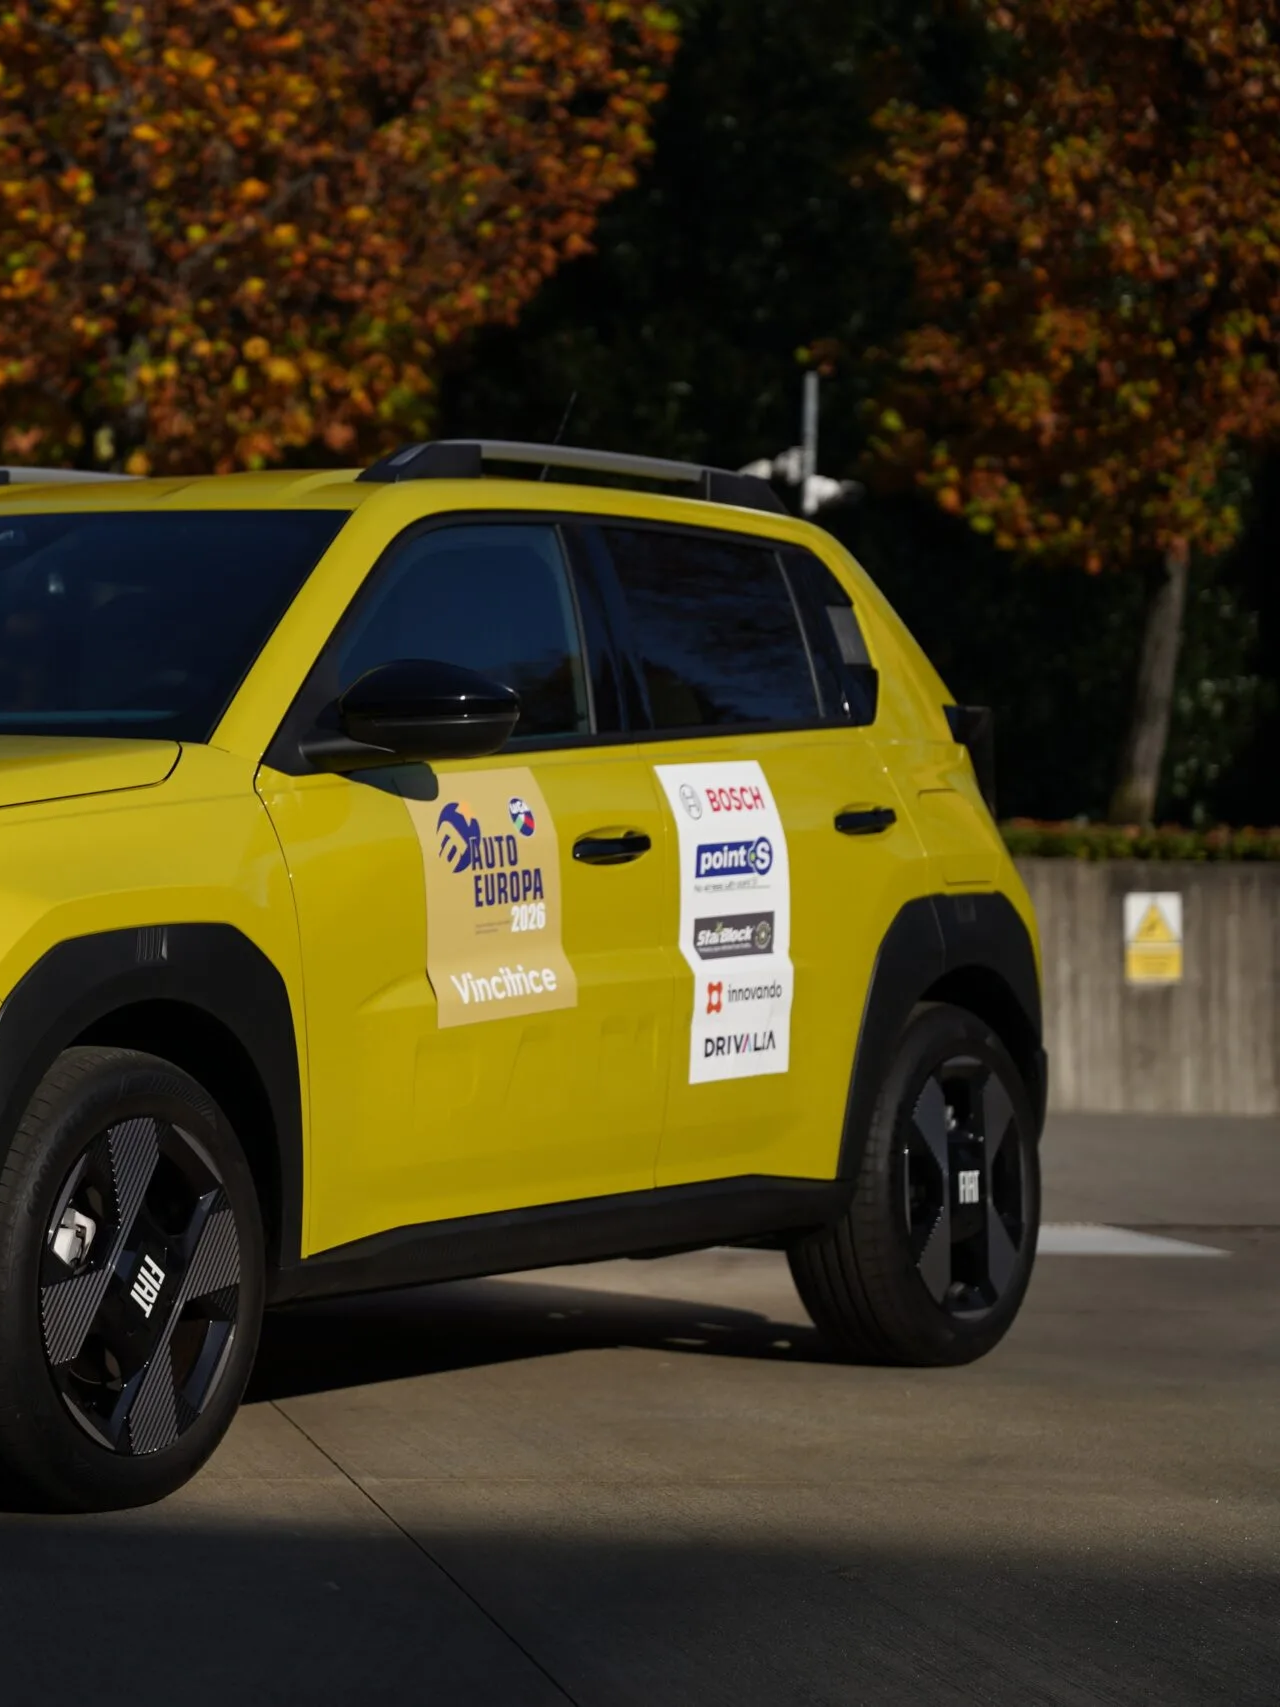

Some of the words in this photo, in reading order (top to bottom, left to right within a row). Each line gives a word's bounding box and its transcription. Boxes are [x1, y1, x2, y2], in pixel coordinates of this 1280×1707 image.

[706, 786, 765, 812] BOSCH
[470, 834, 518, 871] AUTO
[700, 845, 747, 875] point
[474, 868, 544, 907] EUROPA
[511, 902, 546, 932] 2026
[451, 964, 557, 1004] Vincitrice
[728, 979, 782, 1002] innovando
[704, 1030, 776, 1058] DRIVALIA
[958, 1170, 980, 1204] FIAT
[130, 1254, 166, 1319] FIAT
